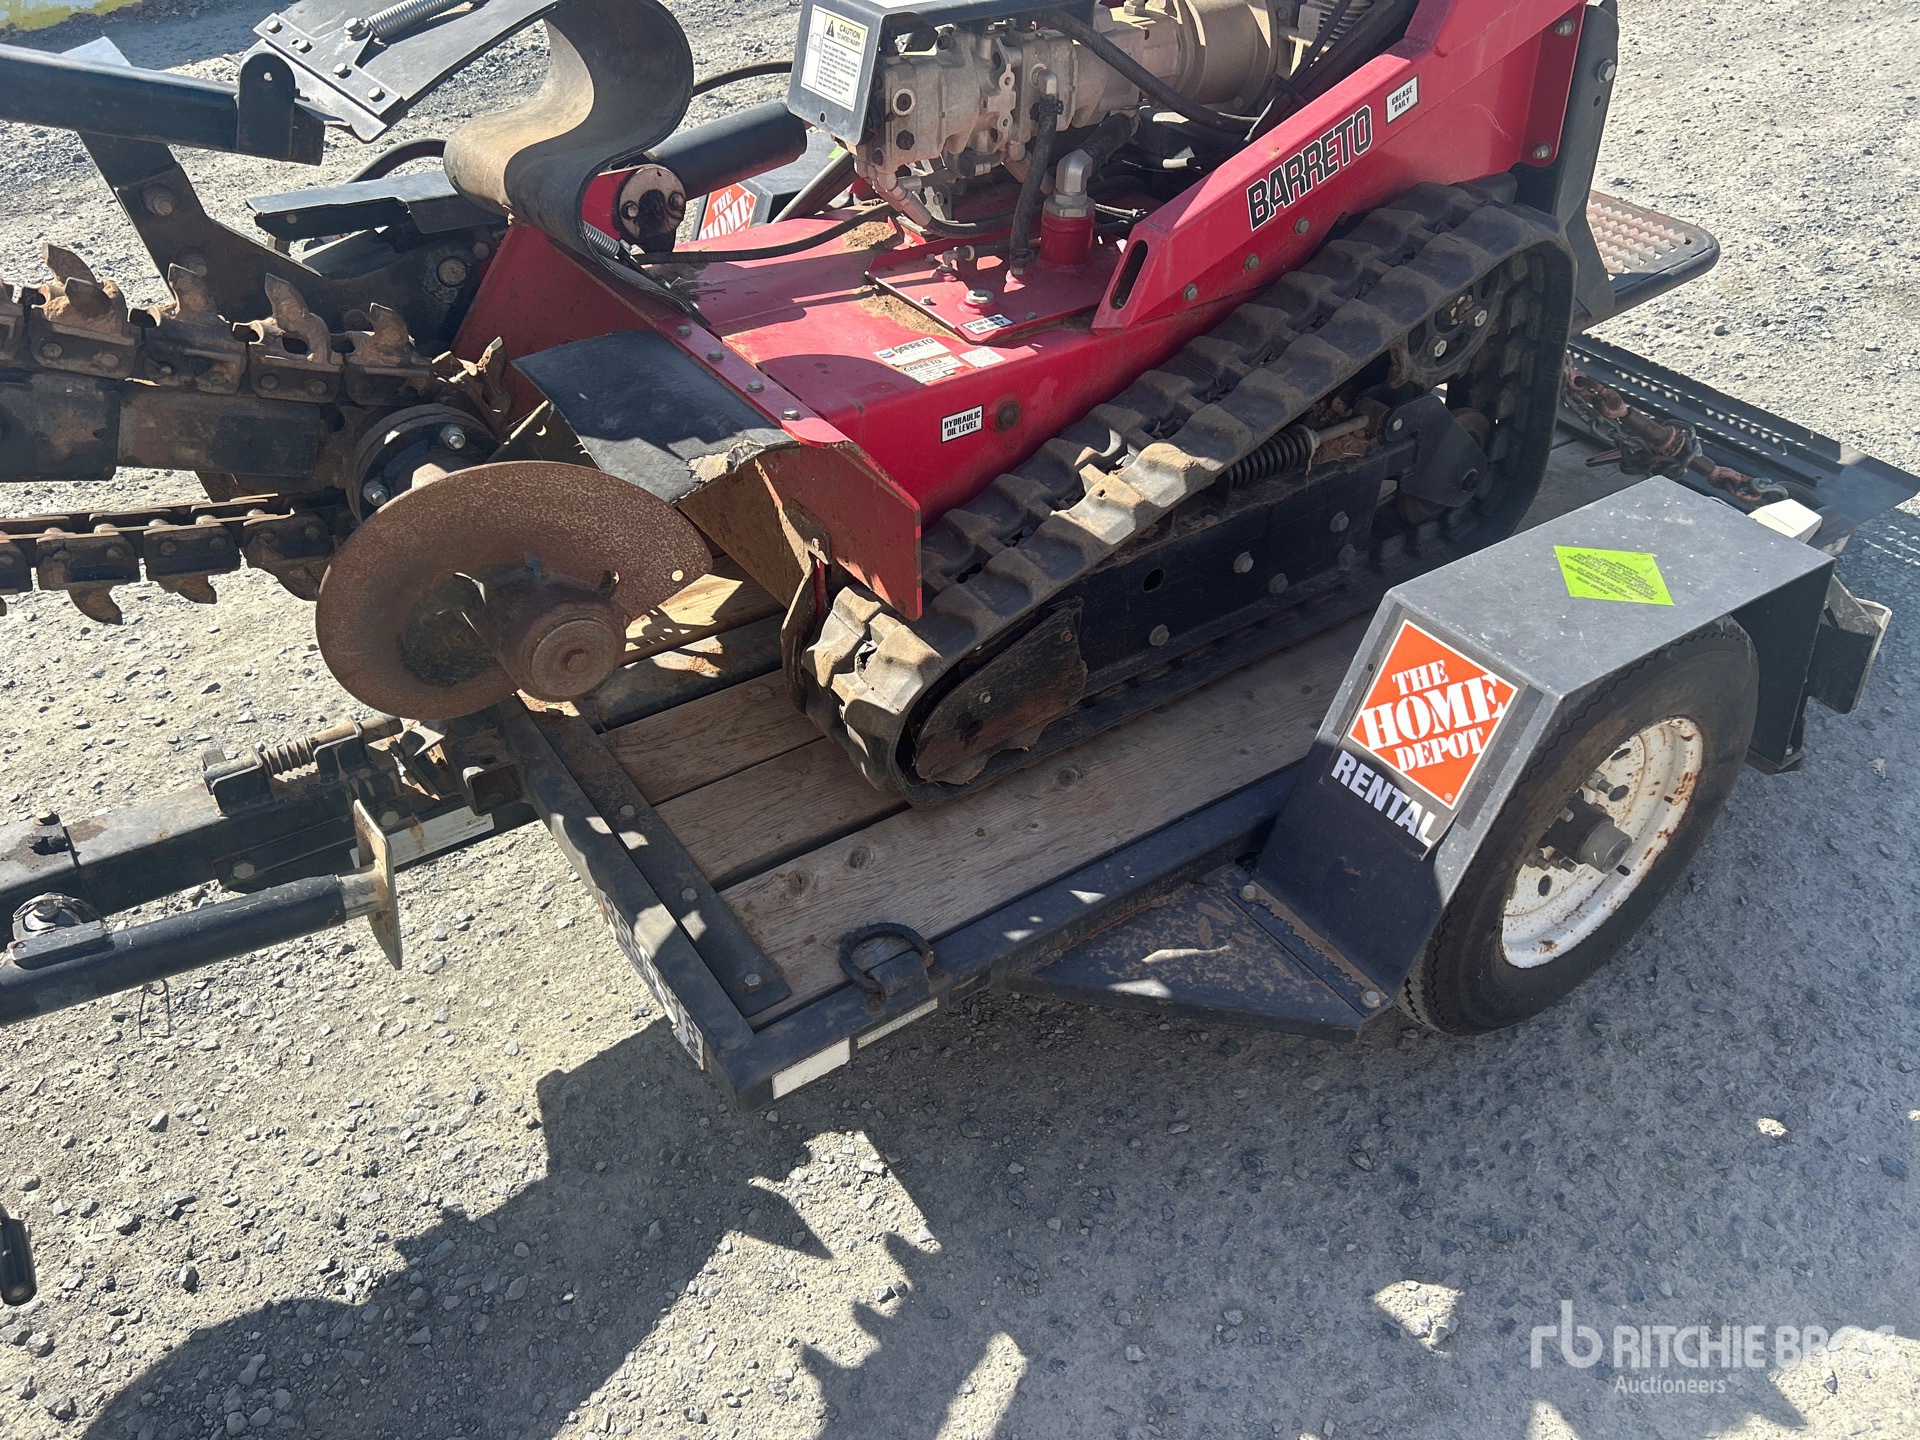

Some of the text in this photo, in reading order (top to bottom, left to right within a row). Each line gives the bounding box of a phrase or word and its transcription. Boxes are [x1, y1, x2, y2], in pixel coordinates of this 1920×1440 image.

[839, 24, 861, 40] CAUTION
[1391, 84, 1413, 106] GREASE
[1394, 95, 1410, 113] DAILY
[1246, 104, 1373, 232] BARRETO
[711, 188, 734, 218] THE
[944, 410, 981, 430] HYDRAULIC
[946, 420, 978, 437] OIL LEVEL
[1391, 659, 1450, 697] THE
[1359, 673, 1505, 751] HOME
[1394, 726, 1484, 773] DEPOT
[1330, 749, 1437, 849] RENTAL
